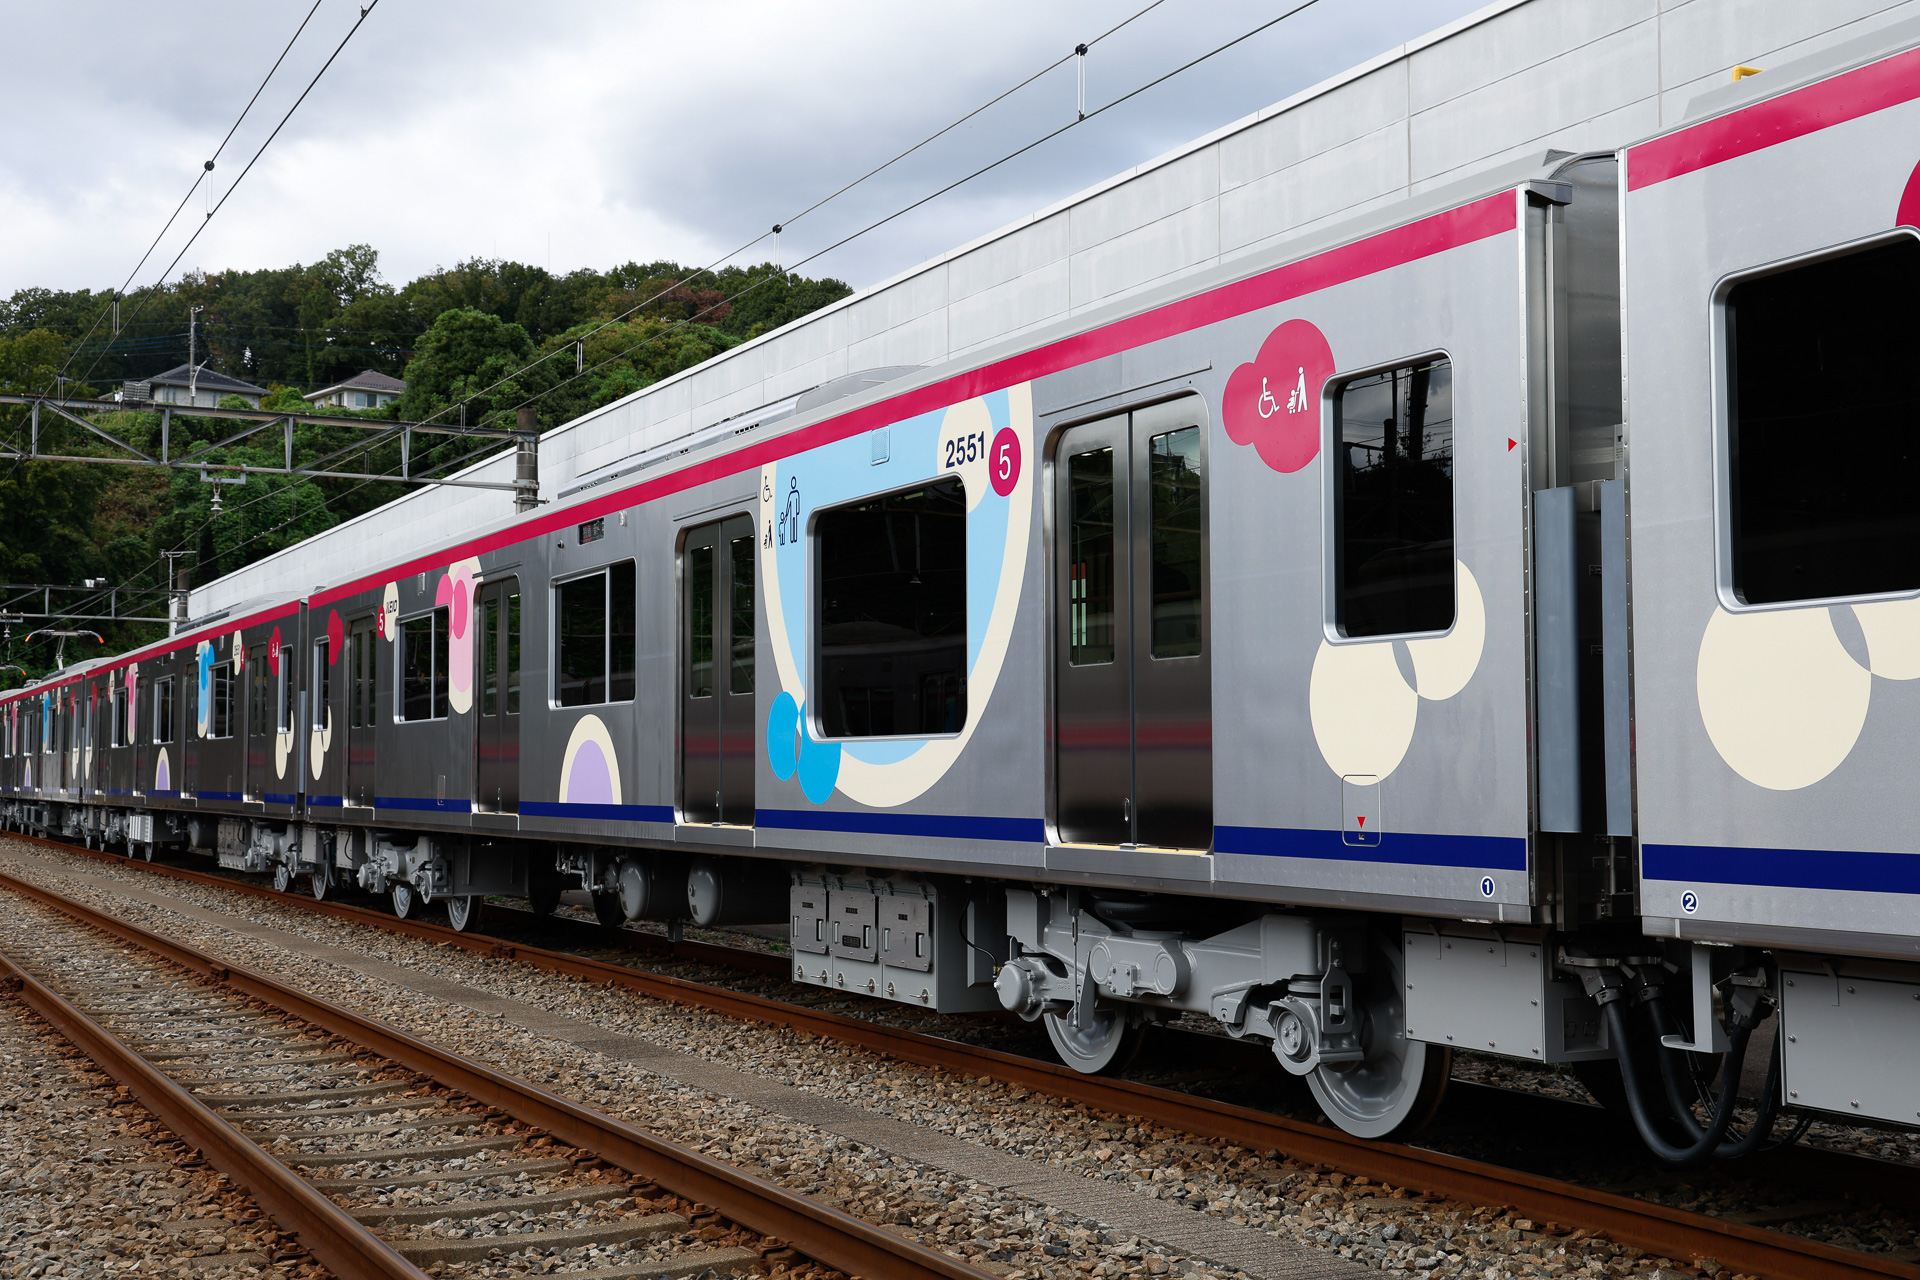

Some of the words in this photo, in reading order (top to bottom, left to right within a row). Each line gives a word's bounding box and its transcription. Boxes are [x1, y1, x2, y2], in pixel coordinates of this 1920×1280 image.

[945, 430, 985, 469] 2551
[998, 443, 1012, 480] 5
[379, 613, 384, 631] 5
